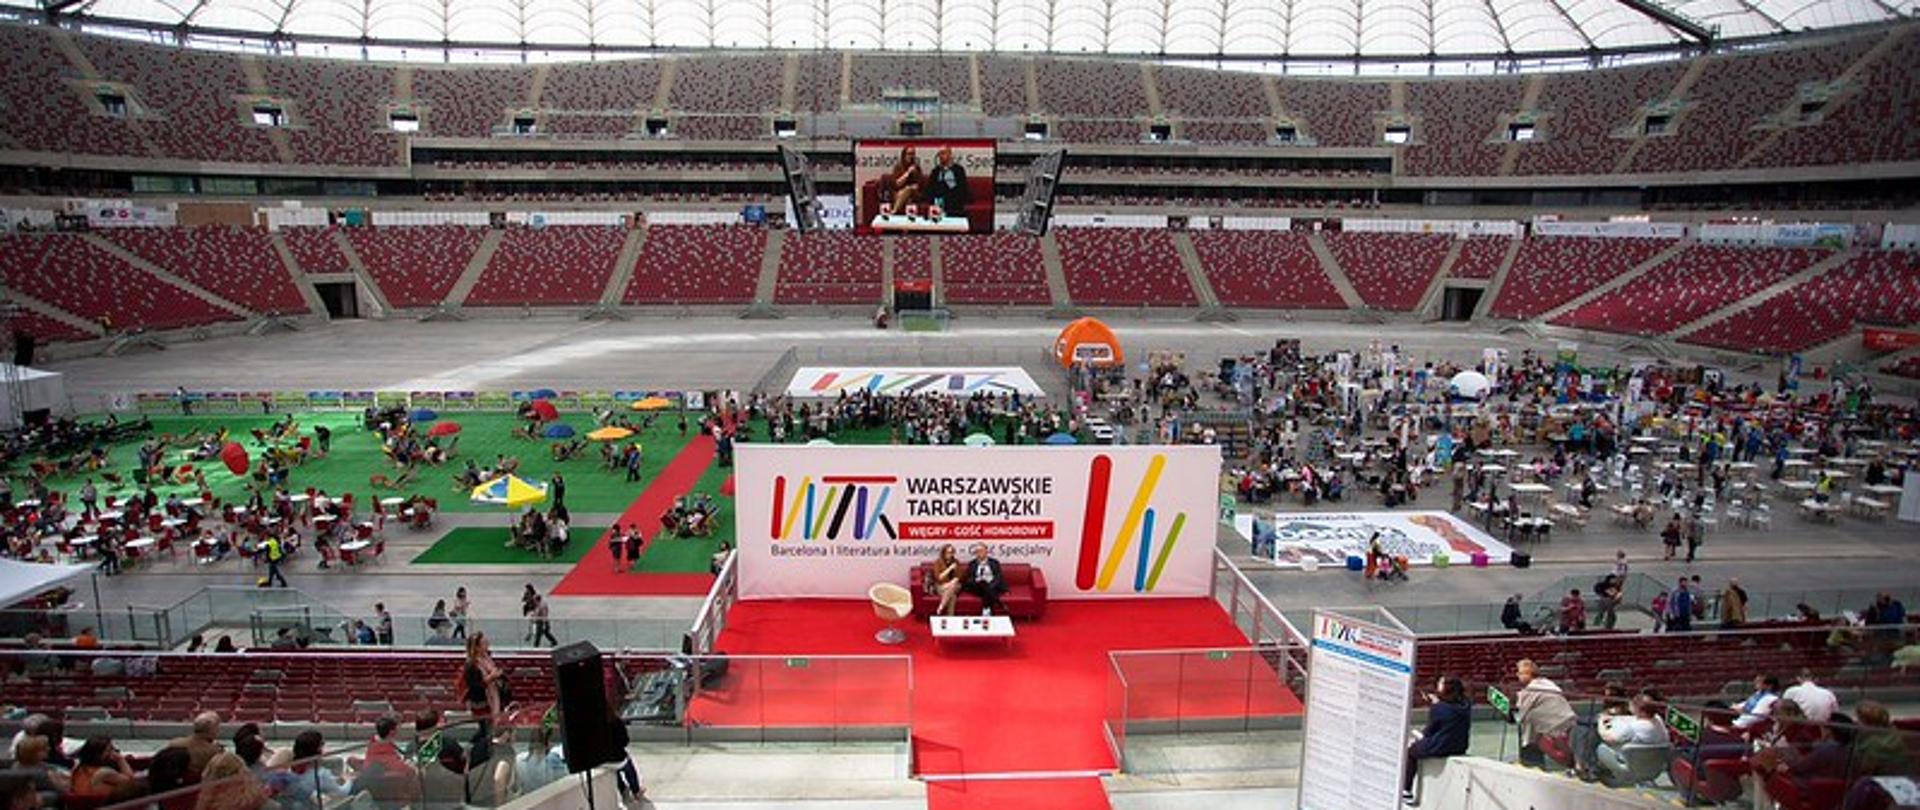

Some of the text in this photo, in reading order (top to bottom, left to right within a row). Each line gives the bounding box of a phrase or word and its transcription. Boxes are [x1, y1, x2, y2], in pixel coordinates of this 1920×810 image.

[906, 477, 1052, 495] WARSZAWSKIE
[906, 494, 1041, 520] TARGI KSIĄŻKI
[907, 526, 947, 538] WĘGRY
[953, 524, 981, 537] GOŚĆ
[983, 526, 1047, 537] HONOROWY
[771, 544, 827, 556] Barcelona
[836, 544, 890, 556] literatura
[998, 544, 1053, 557] Specjalny
